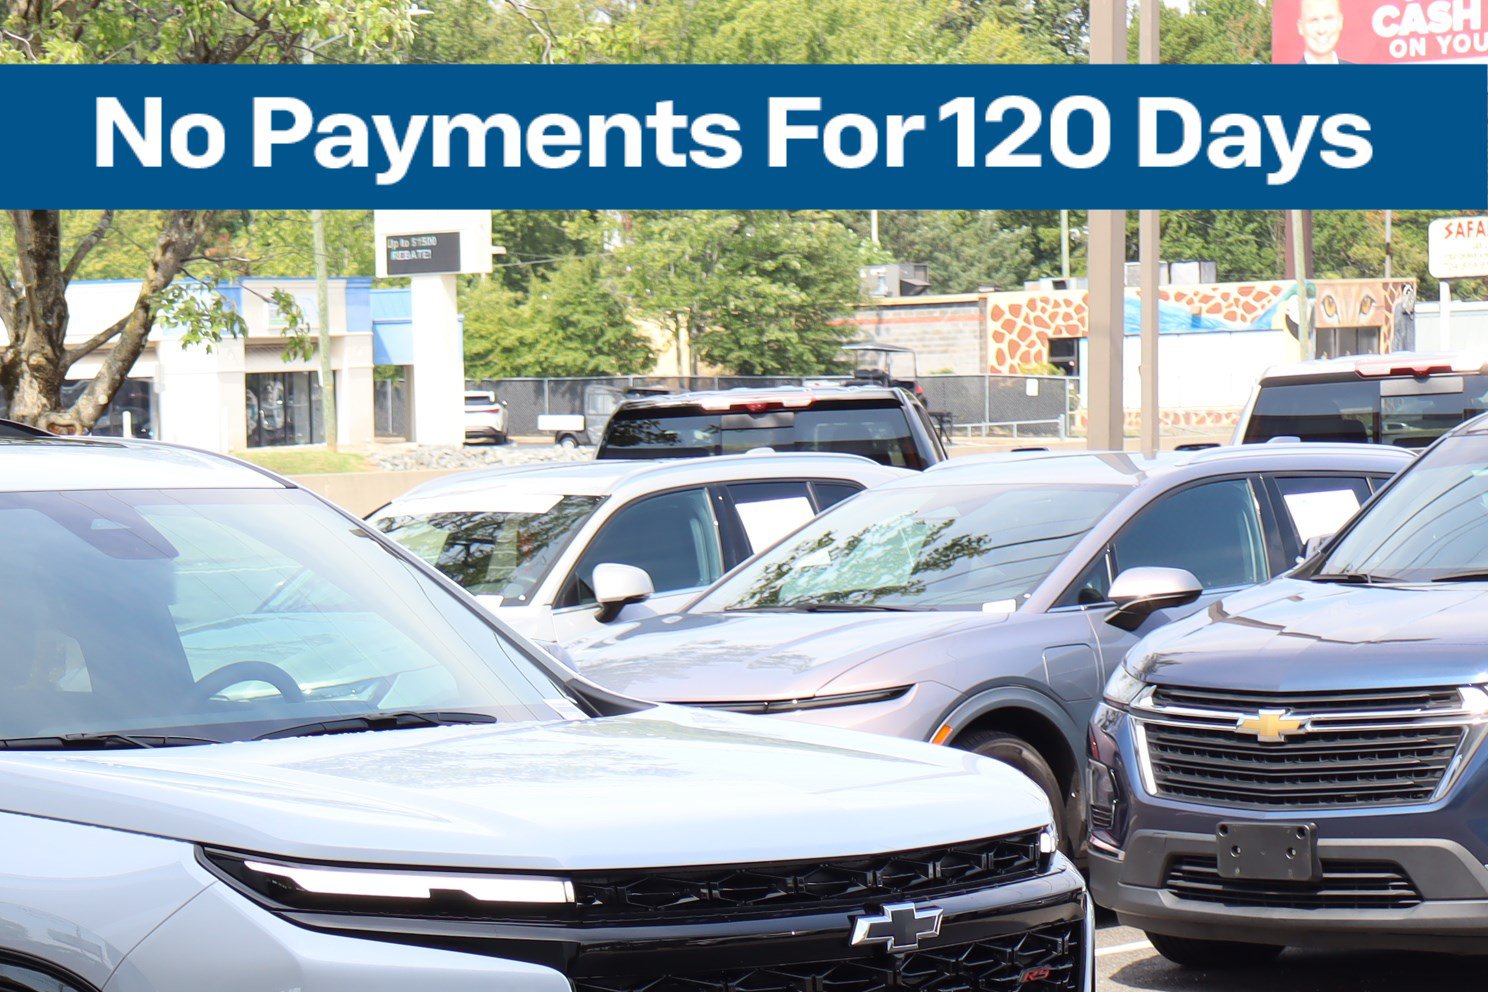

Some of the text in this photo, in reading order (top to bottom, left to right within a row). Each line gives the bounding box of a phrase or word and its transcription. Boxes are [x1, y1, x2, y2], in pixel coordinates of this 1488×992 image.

[1371, 0, 1482, 38] CASH
[1389, 37, 1426, 58] ON
[1444, 220, 1488, 239] SAFA
[1021, 966, 1051, 983] RS
